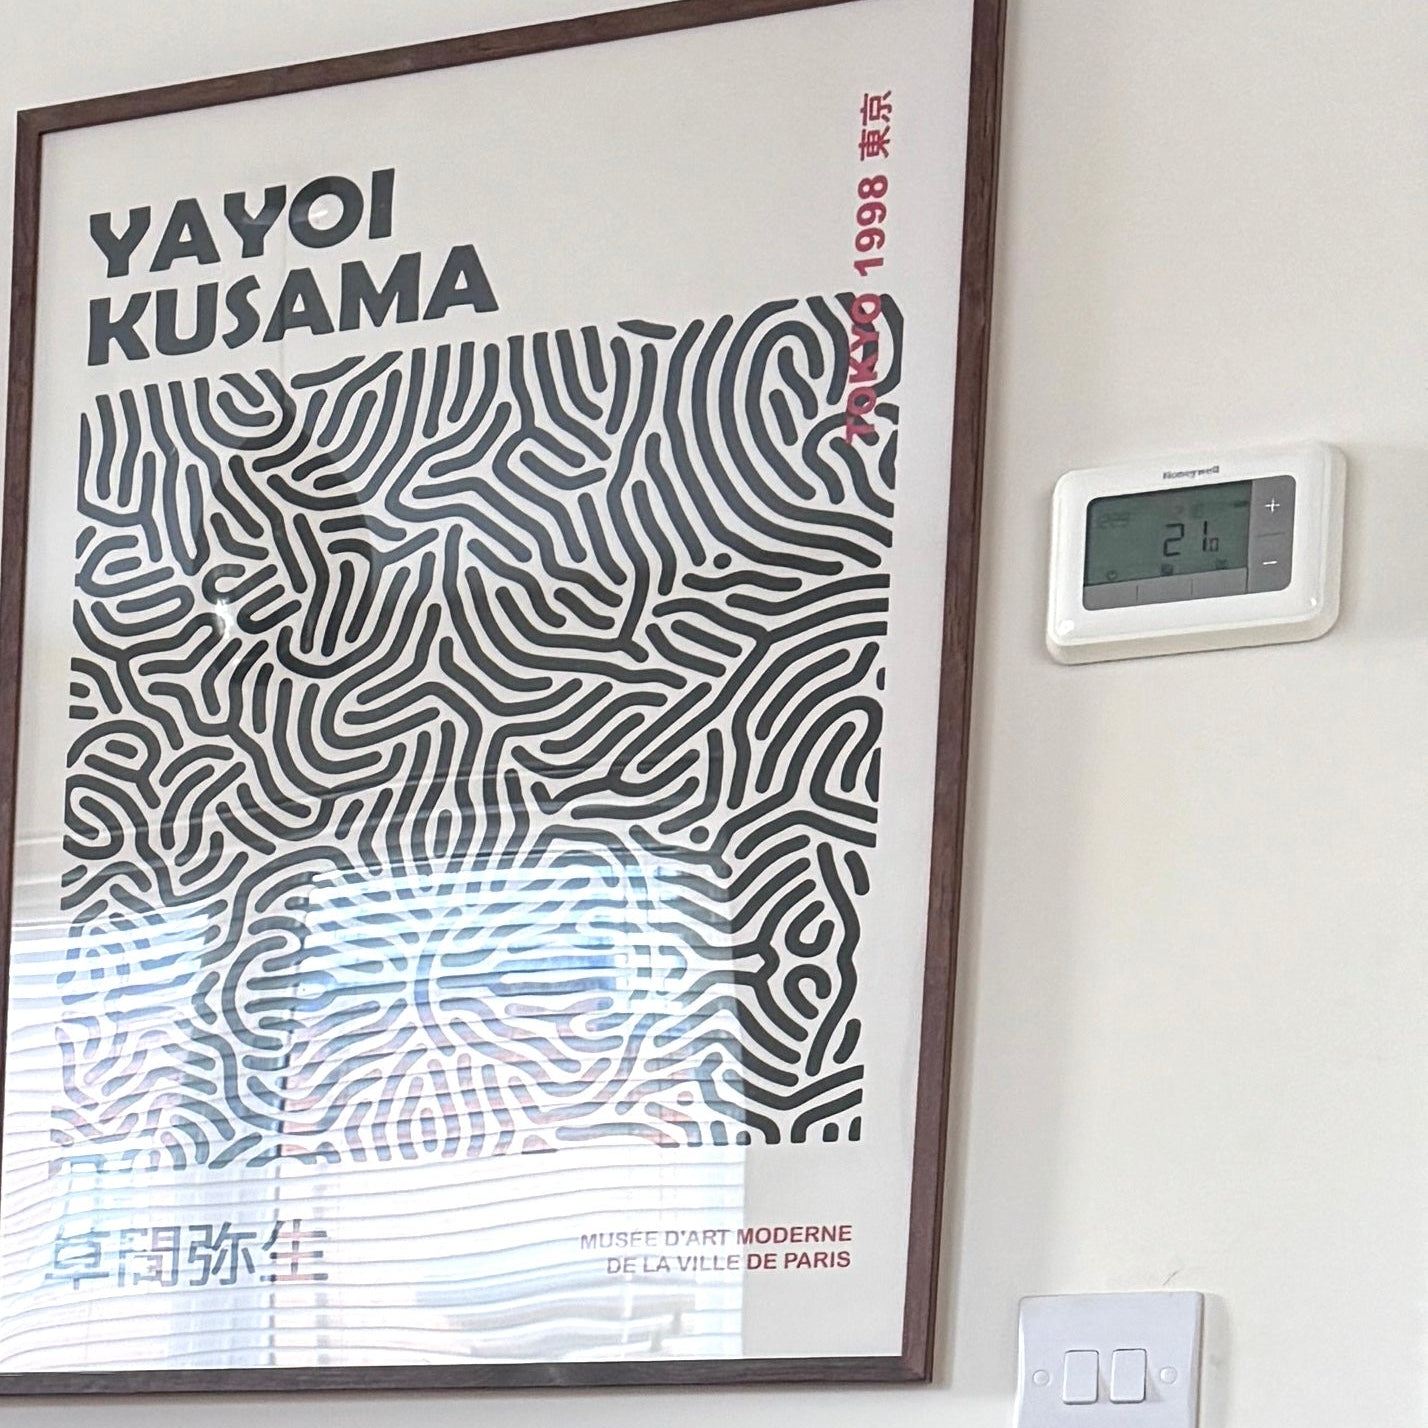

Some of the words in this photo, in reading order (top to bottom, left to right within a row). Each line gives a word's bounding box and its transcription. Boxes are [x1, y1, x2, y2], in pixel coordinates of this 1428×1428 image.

[857, 90, 892, 161] 東京
[90, 168, 395, 278] YAYOI
[853, 174, 888, 277] 1998
[88, 244, 499, 366] KUSAMA
[845, 293, 882, 443] TOKYO
[607, 1256, 636, 1274] DE
[643, 1256, 671, 1273] LA
[676, 1254, 741, 1272] VILLE
[747, 1253, 777, 1270] DE
[784, 1251, 851, 1269] PARIS
[665, 1229, 731, 1247] D'ART
[737, 1225, 853, 1245] MODERNE
